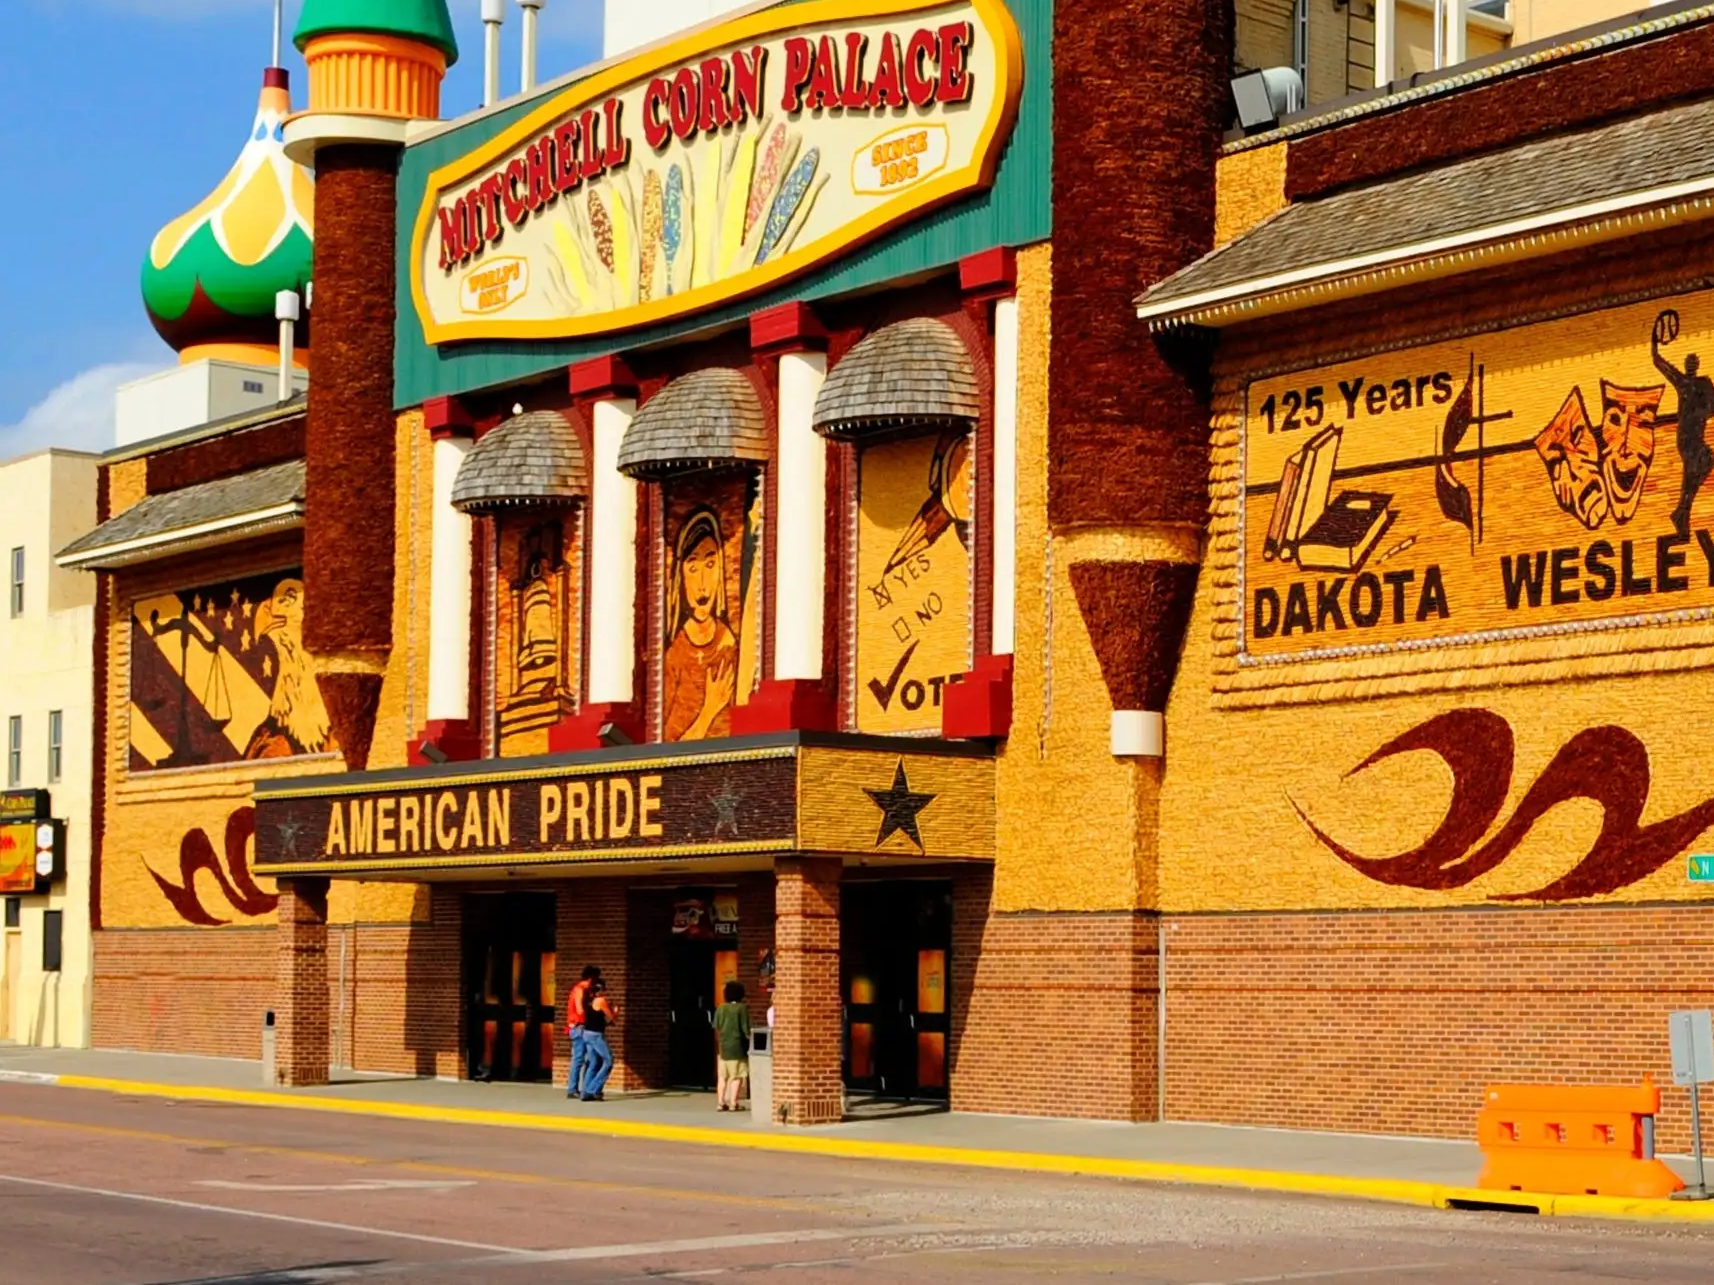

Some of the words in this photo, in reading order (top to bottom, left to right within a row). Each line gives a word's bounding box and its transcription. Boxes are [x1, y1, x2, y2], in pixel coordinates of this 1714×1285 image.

[437, 98, 632, 270] MITCHELL
[643, 45, 768, 149] CORN
[781, 21, 974, 112] PALACE
[872, 130, 928, 167] SINCE
[1260, 386, 1324, 434] 125
[1338, 371, 1452, 419] Years
[893, 553, 931, 587] YES
[1253, 564, 1450, 639] DAKOTA
[915, 592, 943, 626] NO
[867, 639, 964, 712] VOT
[326, 788, 510, 855] AMERICAN
[540, 775, 663, 843] PRIDE
[1701, 861, 1709, 876] N
